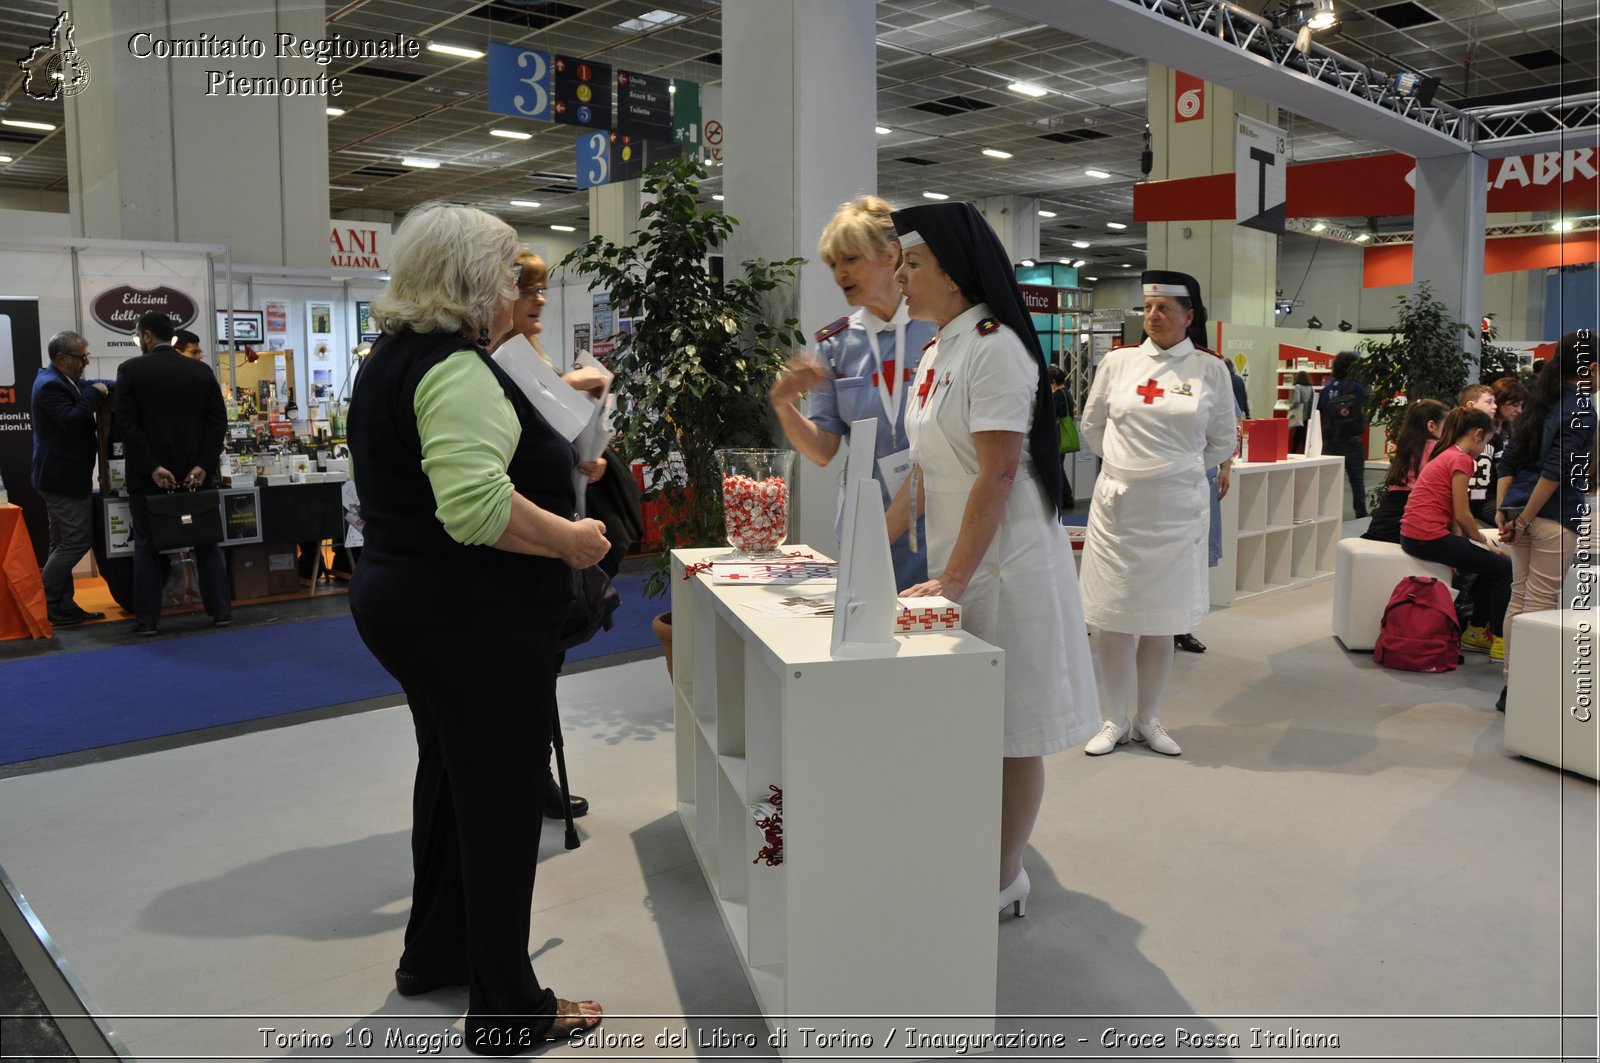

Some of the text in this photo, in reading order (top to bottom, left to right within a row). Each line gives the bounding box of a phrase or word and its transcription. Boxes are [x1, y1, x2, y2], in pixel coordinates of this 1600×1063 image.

[513, 51, 548, 116] 3
[580, 88, 589, 101] 2
[580, 107, 589, 121] 5
[588, 134, 607, 184] 3
[1487, 148, 1599, 192] ABR
[1249, 146, 1275, 217] T
[122, 293, 168, 305] Edizioni
